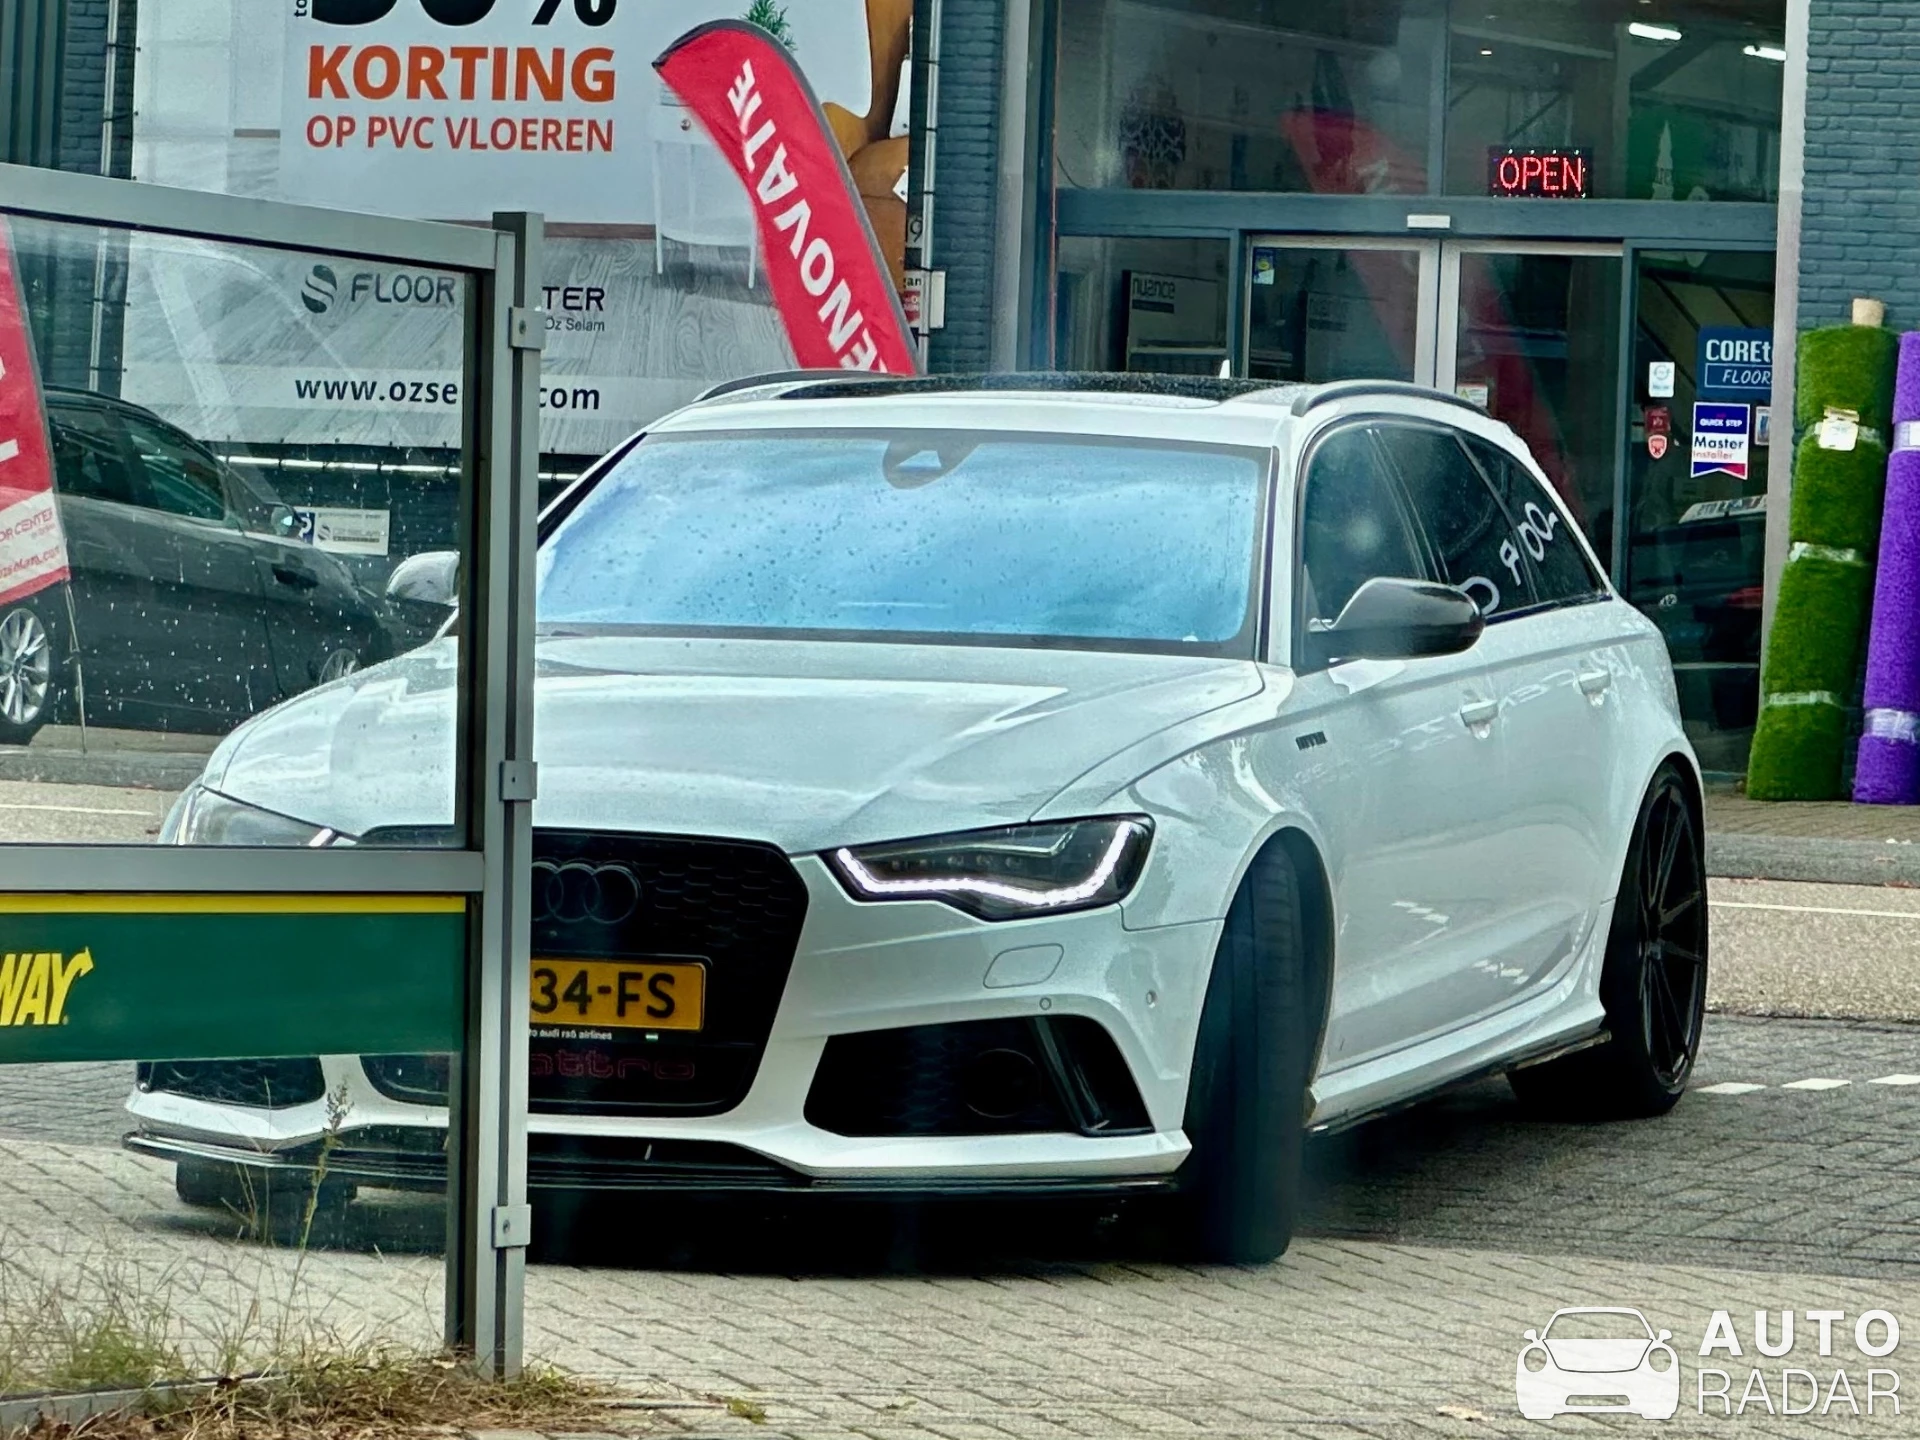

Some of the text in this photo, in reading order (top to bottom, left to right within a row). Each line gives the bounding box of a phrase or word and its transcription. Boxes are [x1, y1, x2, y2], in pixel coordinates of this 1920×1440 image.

[308, 45, 616, 103] KORTING
[306, 114, 614, 152] OP PVC VLOEREN
[1499, 156, 1581, 192] OPEN
[726, 58, 888, 374] ENOVATIE
[351, 273, 605, 312] FLOOR TER
[1693, 449, 1733, 461] Installer
[1694, 435, 1744, 450] Master
[0, 946, 94, 1026] WAY
